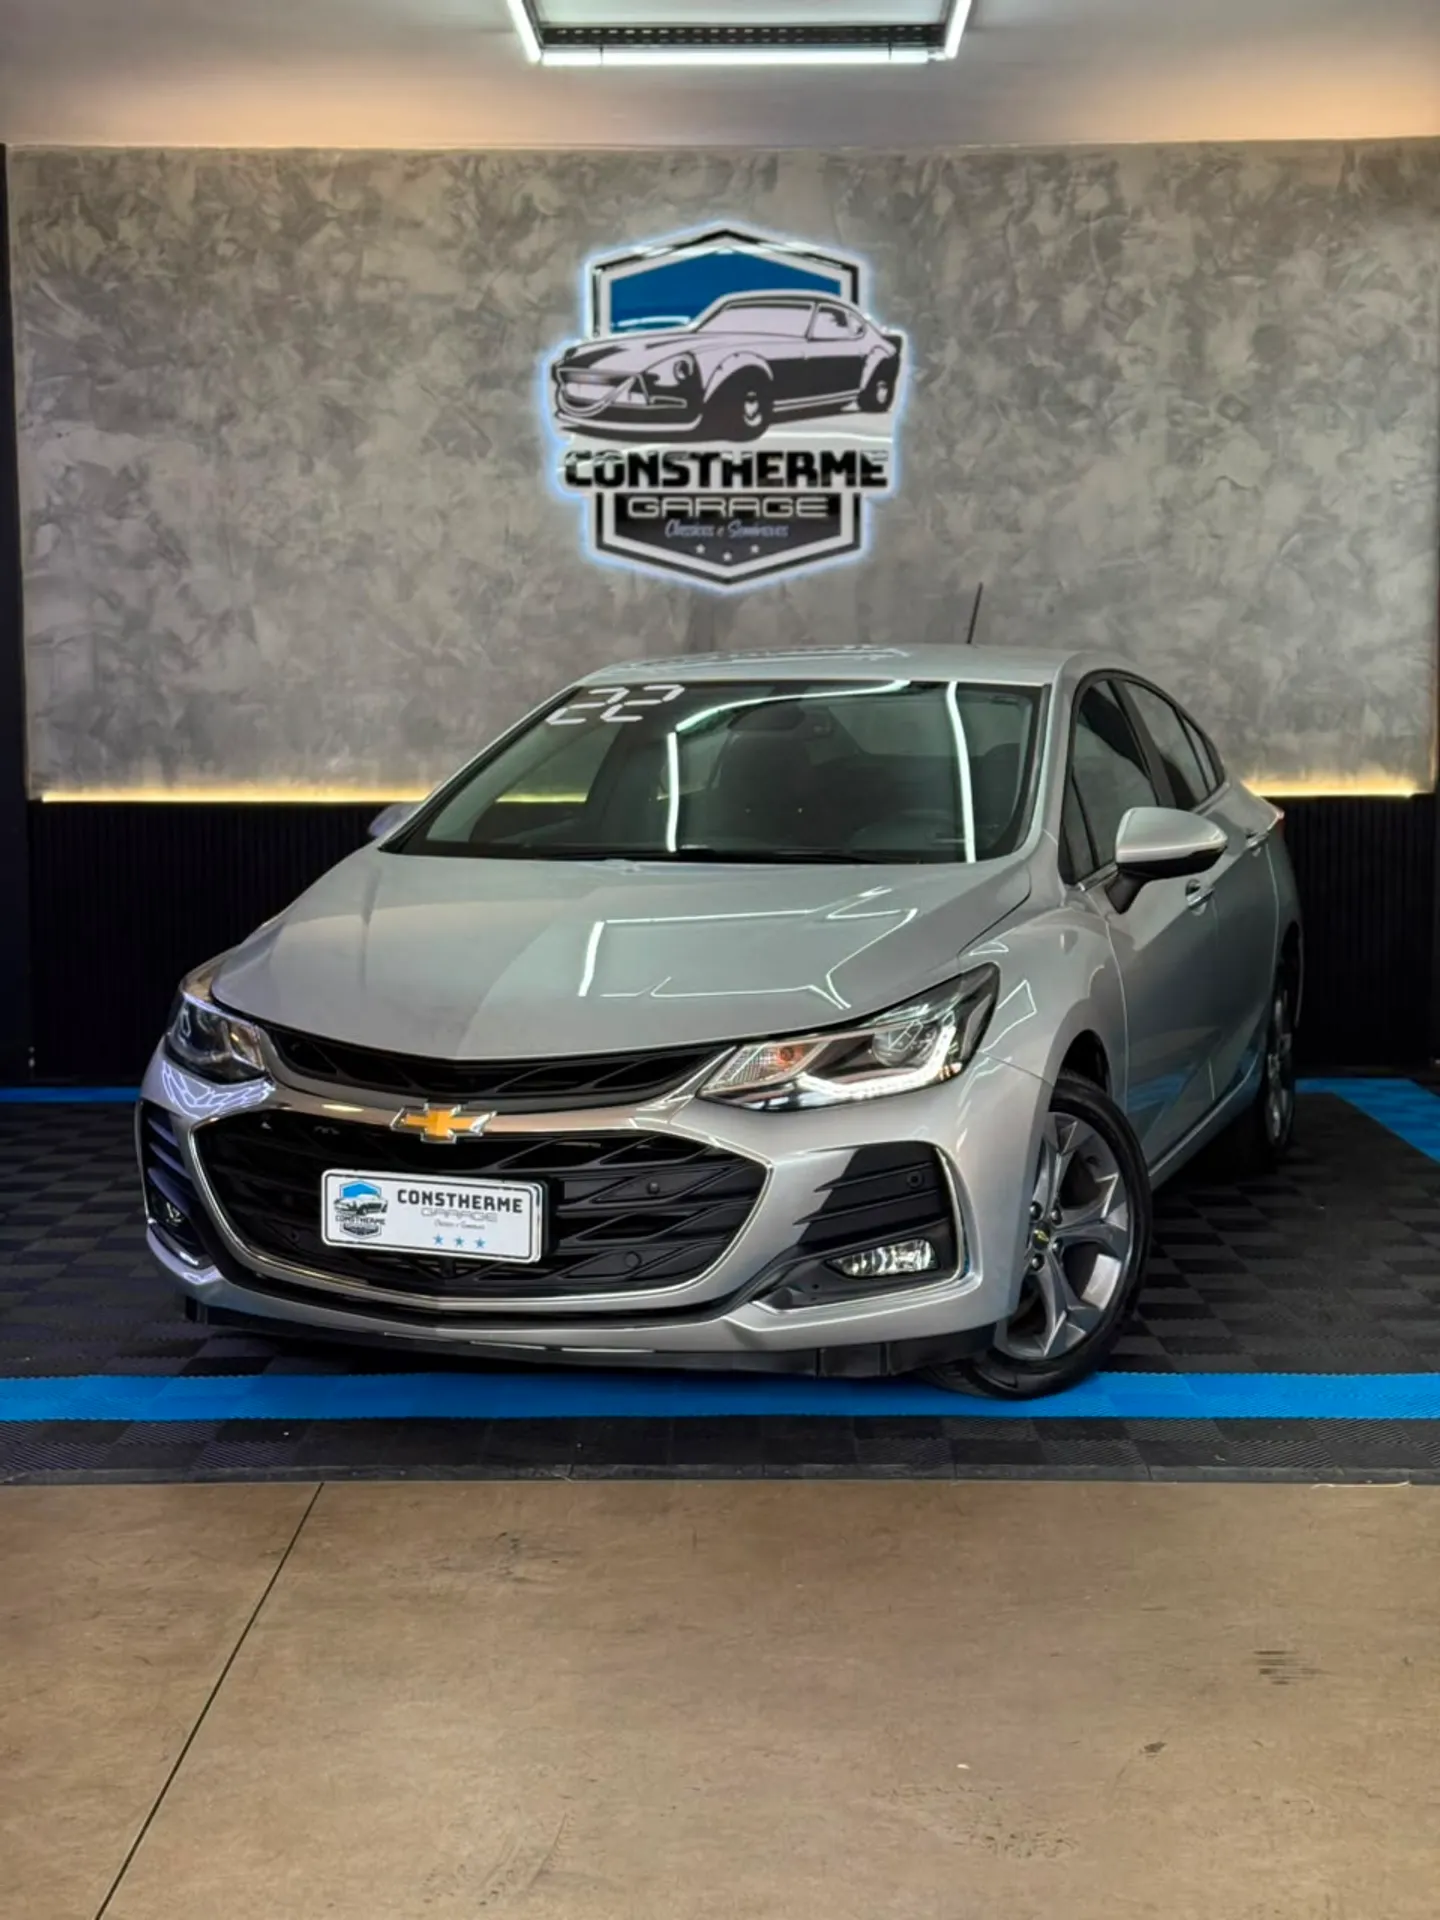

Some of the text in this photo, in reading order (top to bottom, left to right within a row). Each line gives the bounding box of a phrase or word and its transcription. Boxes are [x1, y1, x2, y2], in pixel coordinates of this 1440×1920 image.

[564, 450, 888, 488] CONSTHERME
[627, 497, 829, 519] GARAGE
[545, 684, 685, 725] 22
[397, 1189, 523, 1213] CONSTHERME
